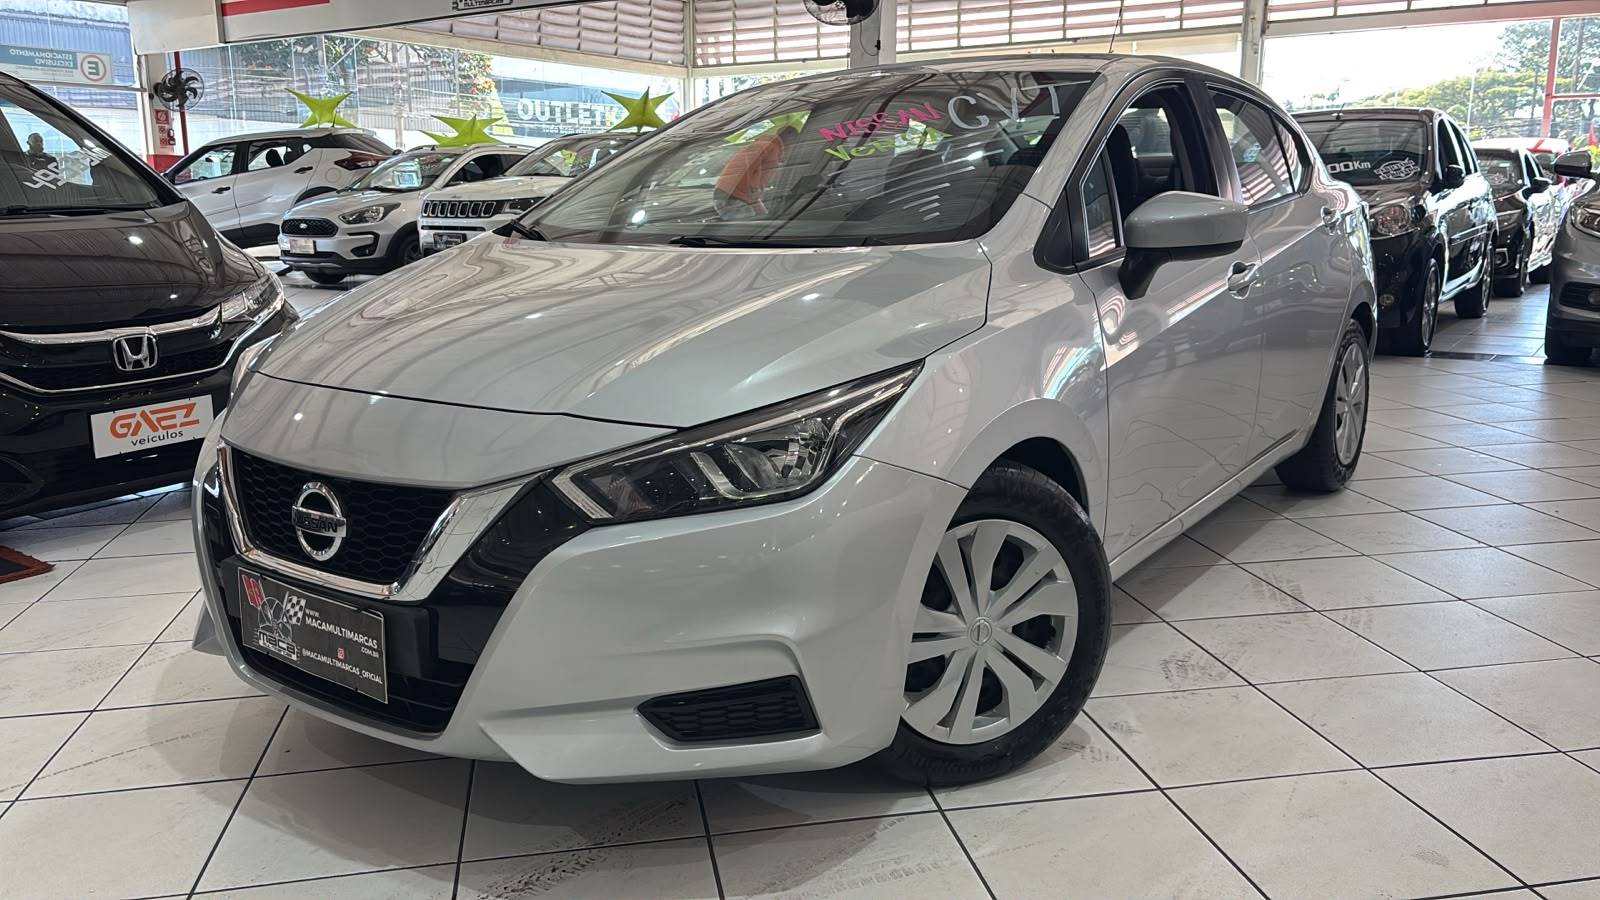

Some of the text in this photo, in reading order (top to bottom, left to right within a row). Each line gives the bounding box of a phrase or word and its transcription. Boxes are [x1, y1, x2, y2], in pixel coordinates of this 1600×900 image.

[818, 102, 942, 142] NISSAN
[948, 81, 1090, 130] CVT
[110, 402, 200, 438] GAEZ
[295, 508, 338, 534] SSAN
[305, 615, 379, 650] MACAMULTIMARCAS
